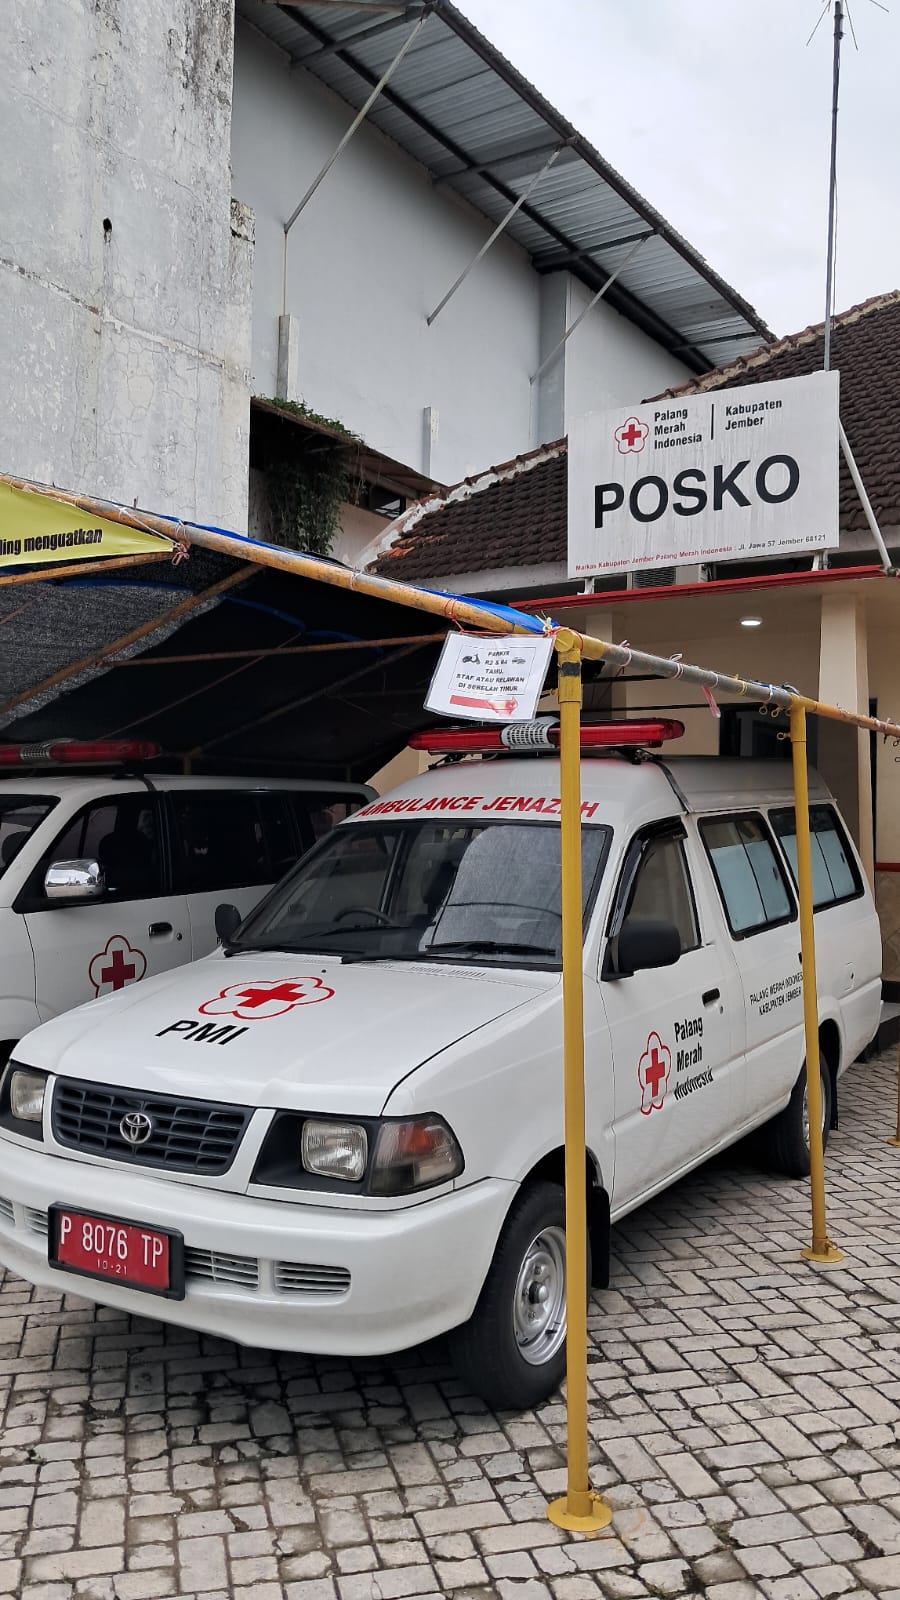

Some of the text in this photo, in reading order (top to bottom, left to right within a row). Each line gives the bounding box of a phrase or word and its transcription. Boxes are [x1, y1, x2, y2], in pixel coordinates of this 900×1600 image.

[654, 408, 688, 422] Palang
[725, 400, 783, 416] Kabupaten
[654, 421, 686, 436] Merah
[725, 416, 764, 431] Jember
[654, 433, 703, 450] Indonesia
[594, 454, 800, 529] POSKO
[24, 528, 103, 552] menguatkan
[575, 562, 597, 571] Markas
[598, 558, 631, 569] Kabupaten
[632, 555, 655, 564] Jember
[655, 551, 678, 561] Palang
[679, 549, 699, 558] Merah
[700, 545, 733, 555] Indonesia
[777, 537, 805, 546] Jember
[354, 796, 600, 818] AMBULANCE JENAZH
[784, 971, 803, 988] INDONES
[155, 1019, 250, 1046] PMI
[674, 1016, 703, 1043] Palang
[676, 1043, 703, 1072] Merah
[673, 1064, 714, 1101] Indonesia
[60, 1215, 163, 1268] P 8076 TP
